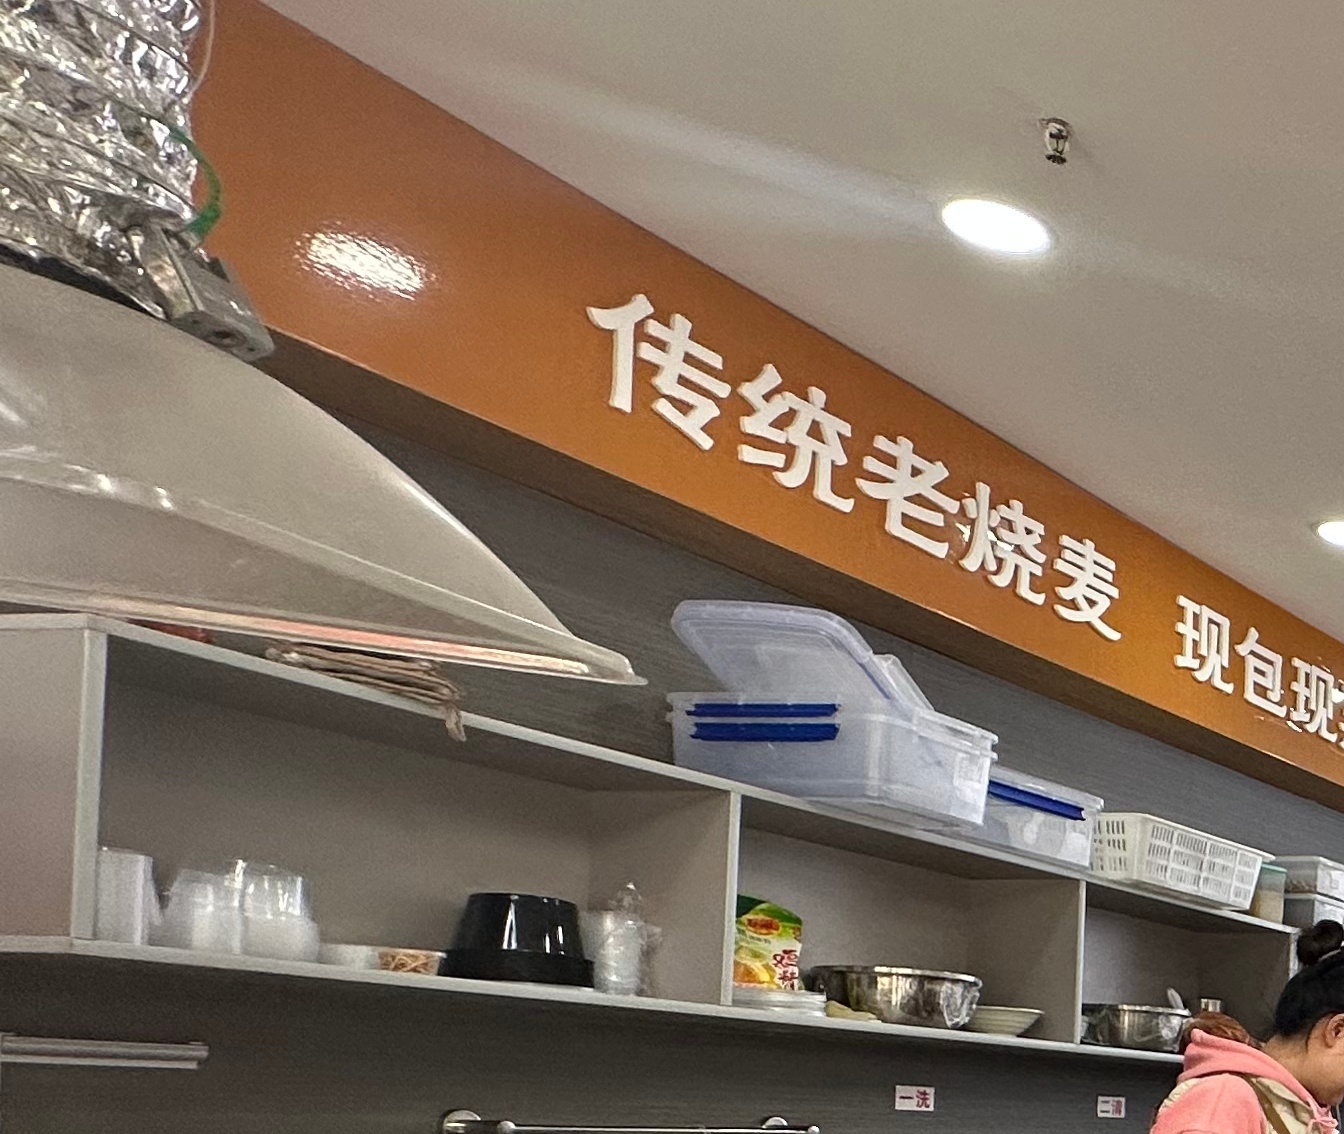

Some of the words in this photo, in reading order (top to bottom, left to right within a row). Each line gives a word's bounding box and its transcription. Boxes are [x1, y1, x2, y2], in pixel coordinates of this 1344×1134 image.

[586, 292, 1123, 641] 传统老烧麦
[899, 1089, 930, 1109] 一洗
